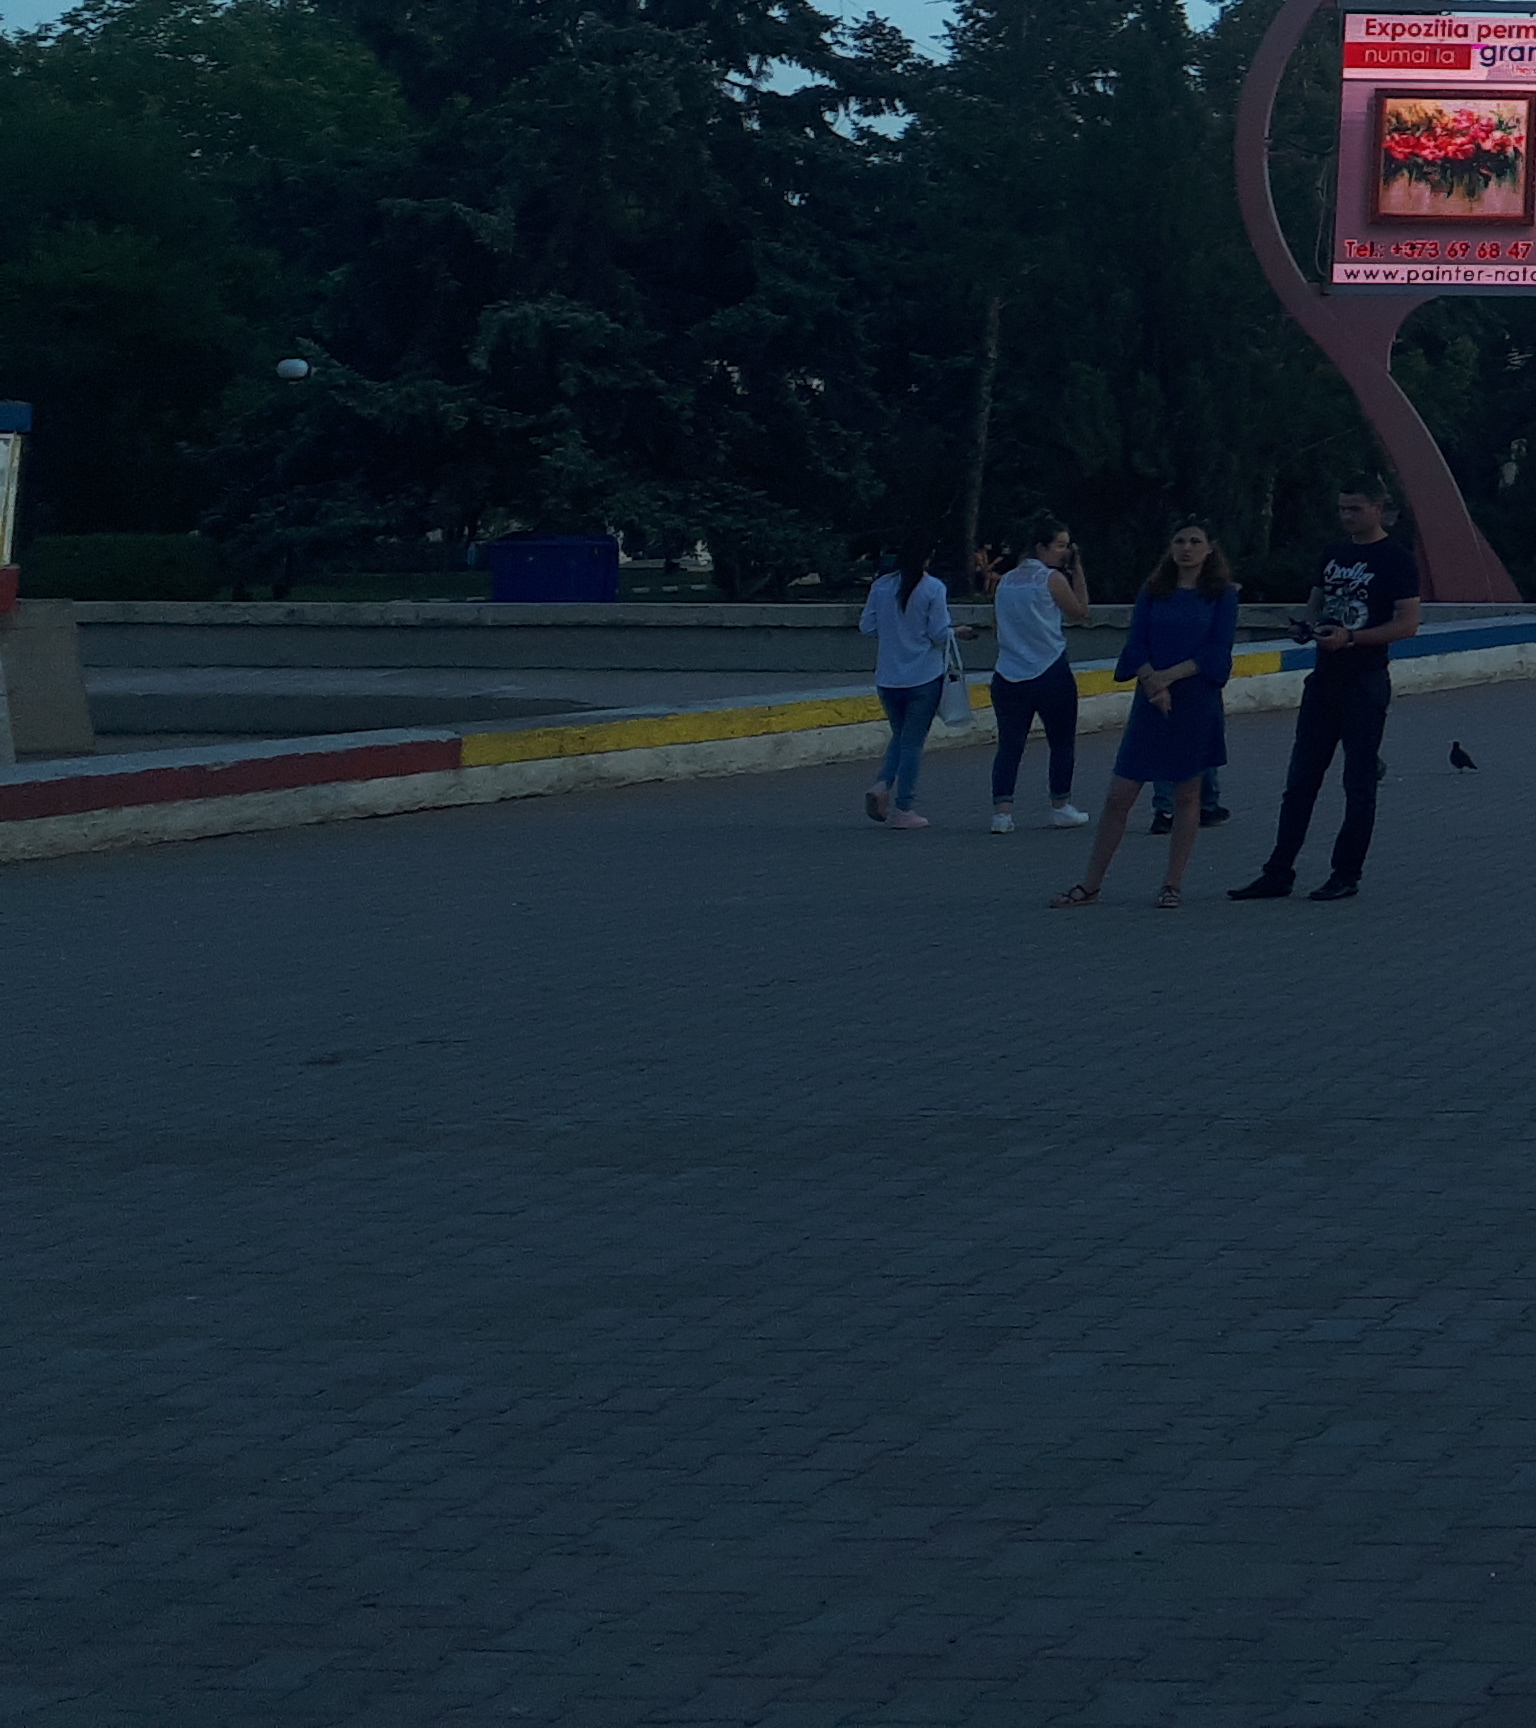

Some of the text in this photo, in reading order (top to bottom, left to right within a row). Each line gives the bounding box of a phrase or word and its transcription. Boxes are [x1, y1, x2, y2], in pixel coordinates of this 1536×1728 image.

[1364, 45, 1455, 64] numai la
[1446, 240, 1471, 260] 69
[1476, 241, 1502, 260] 68
[1506, 241, 1533, 260] 47
